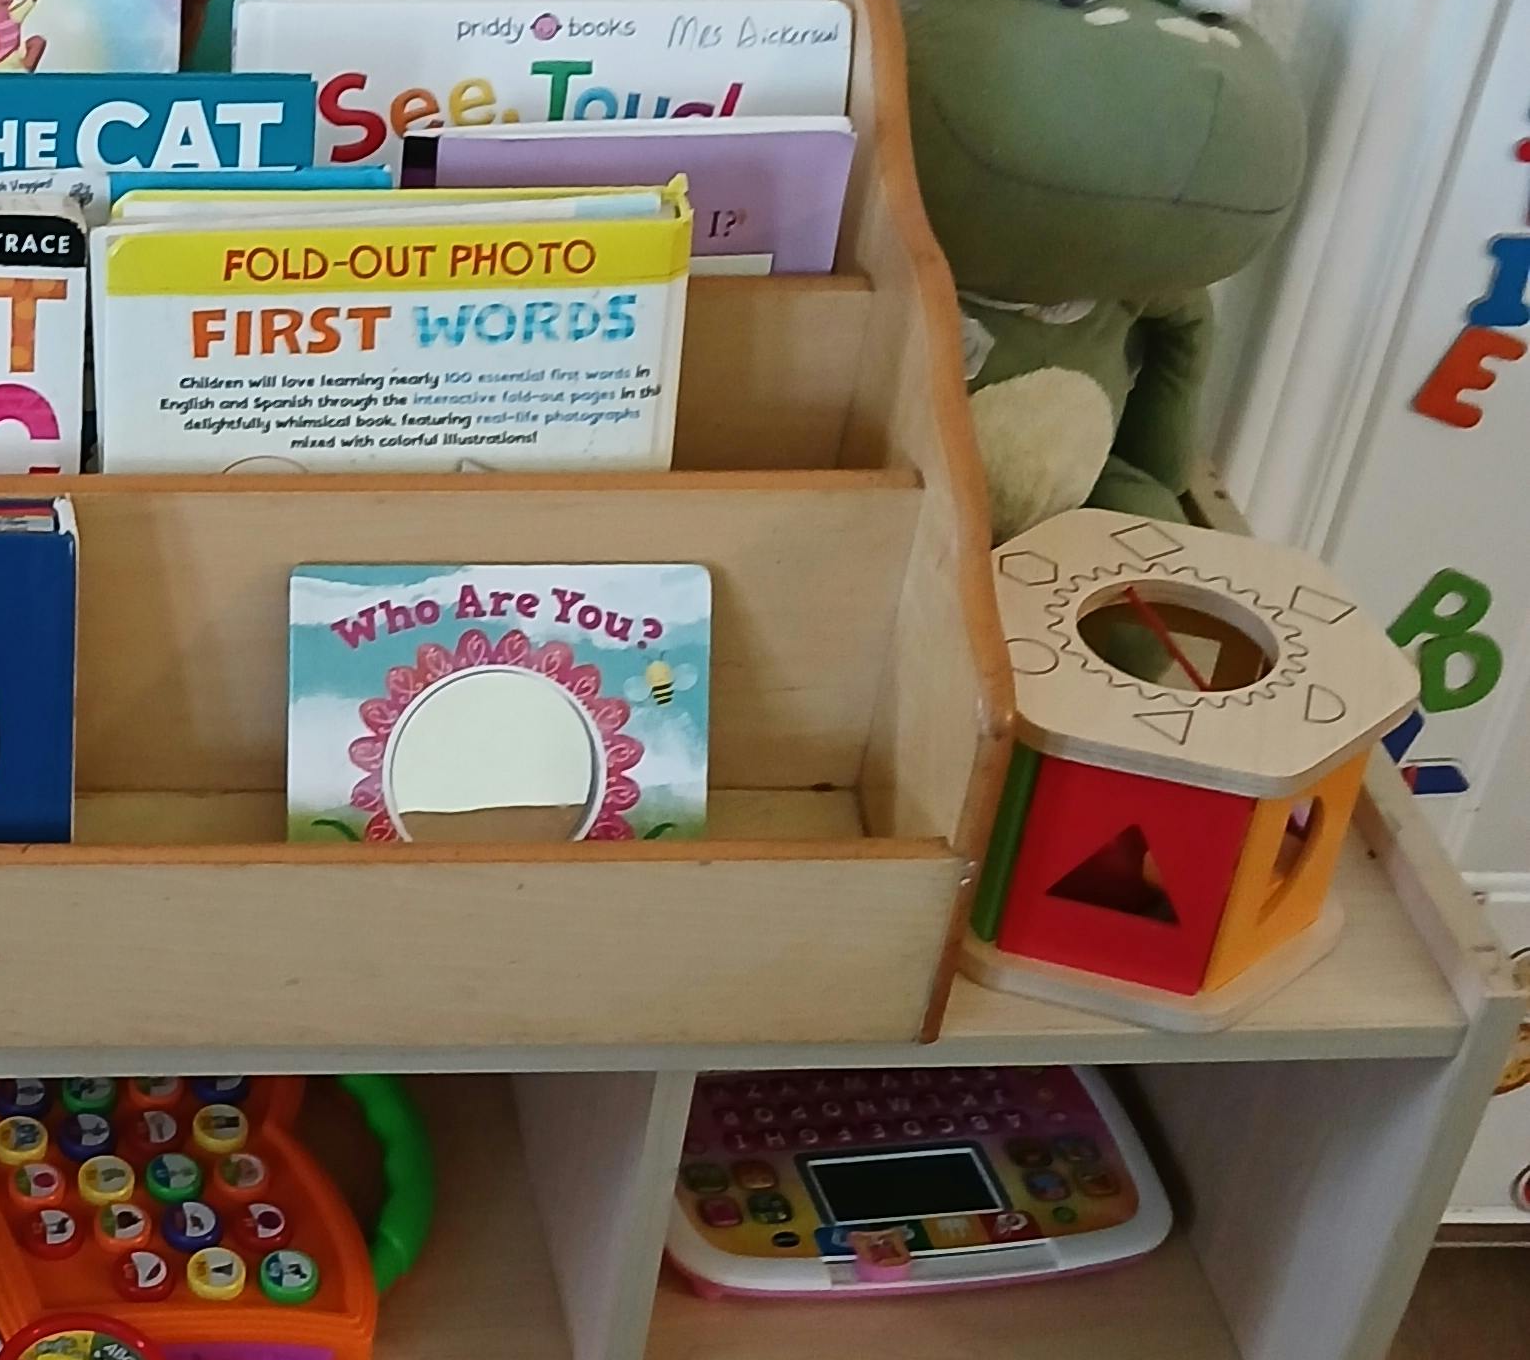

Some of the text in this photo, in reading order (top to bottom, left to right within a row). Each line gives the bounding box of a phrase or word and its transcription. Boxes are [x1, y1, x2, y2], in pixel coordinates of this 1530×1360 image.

[456, 17, 637, 43] priddy books
[318, 72, 521, 163] See,
[76, 100, 285, 172] CAT
[223, 239, 597, 282] FOLD-OUT PHOTO
[190, 292, 638, 360] FIRST WORDS
[179, 364, 651, 391] Children will love learning nearly 100 essential first words in
[159, 396, 215, 416] English
[219, 397, 249, 409] and
[253, 394, 314, 413] Spanish
[318, 393, 378, 411] through
[382, 394, 408, 407] the
[413, 391, 496, 405] interactive
[502, 390, 565, 404] fold-out
[571, 389, 616, 405] pages
[620, 387, 635, 399] in
[184, 416, 271, 435] delightfully
[275, 414, 351, 429] whimsical
[401, 413, 471, 430] featuring
[476, 409, 539, 424] real-life
[544, 408, 641, 426] photographs
[290, 430, 538, 449] mixed with colorful illustrations!
[330, 584, 664, 650] Who Are You?
